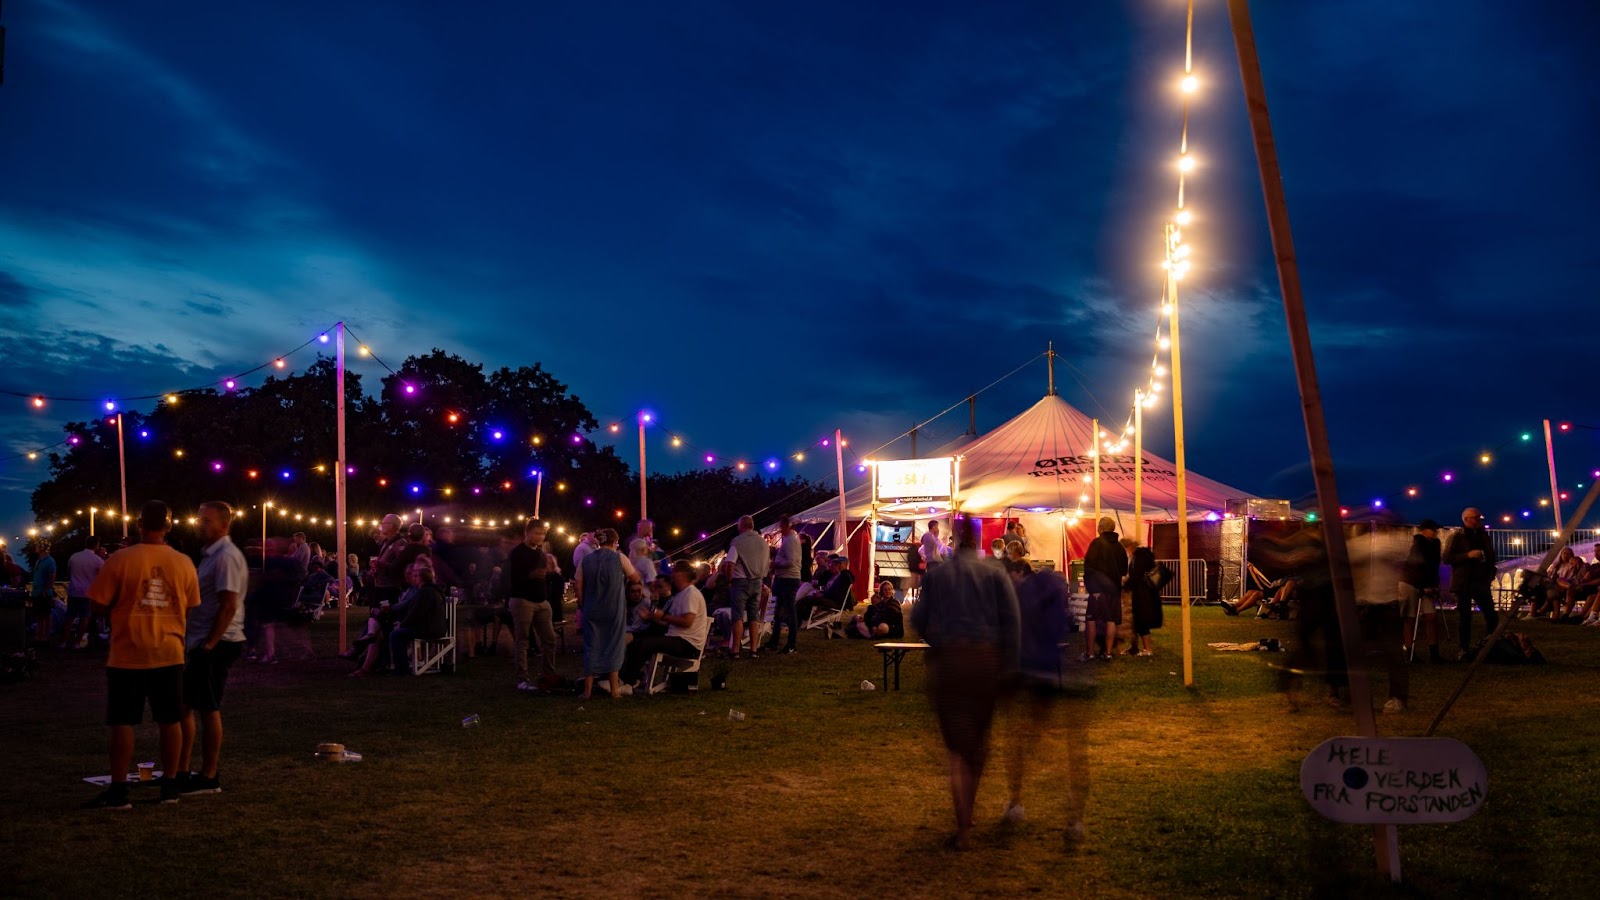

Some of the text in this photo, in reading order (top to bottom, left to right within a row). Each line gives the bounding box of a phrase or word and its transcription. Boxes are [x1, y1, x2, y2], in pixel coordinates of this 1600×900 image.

[1035, 454, 1150, 469] ØRSTED
[1327, 743, 1391, 766] HELE
[1374, 768, 1462, 793] VERDEN
[1313, 781, 1483, 814] FRA FORSTANDEN
